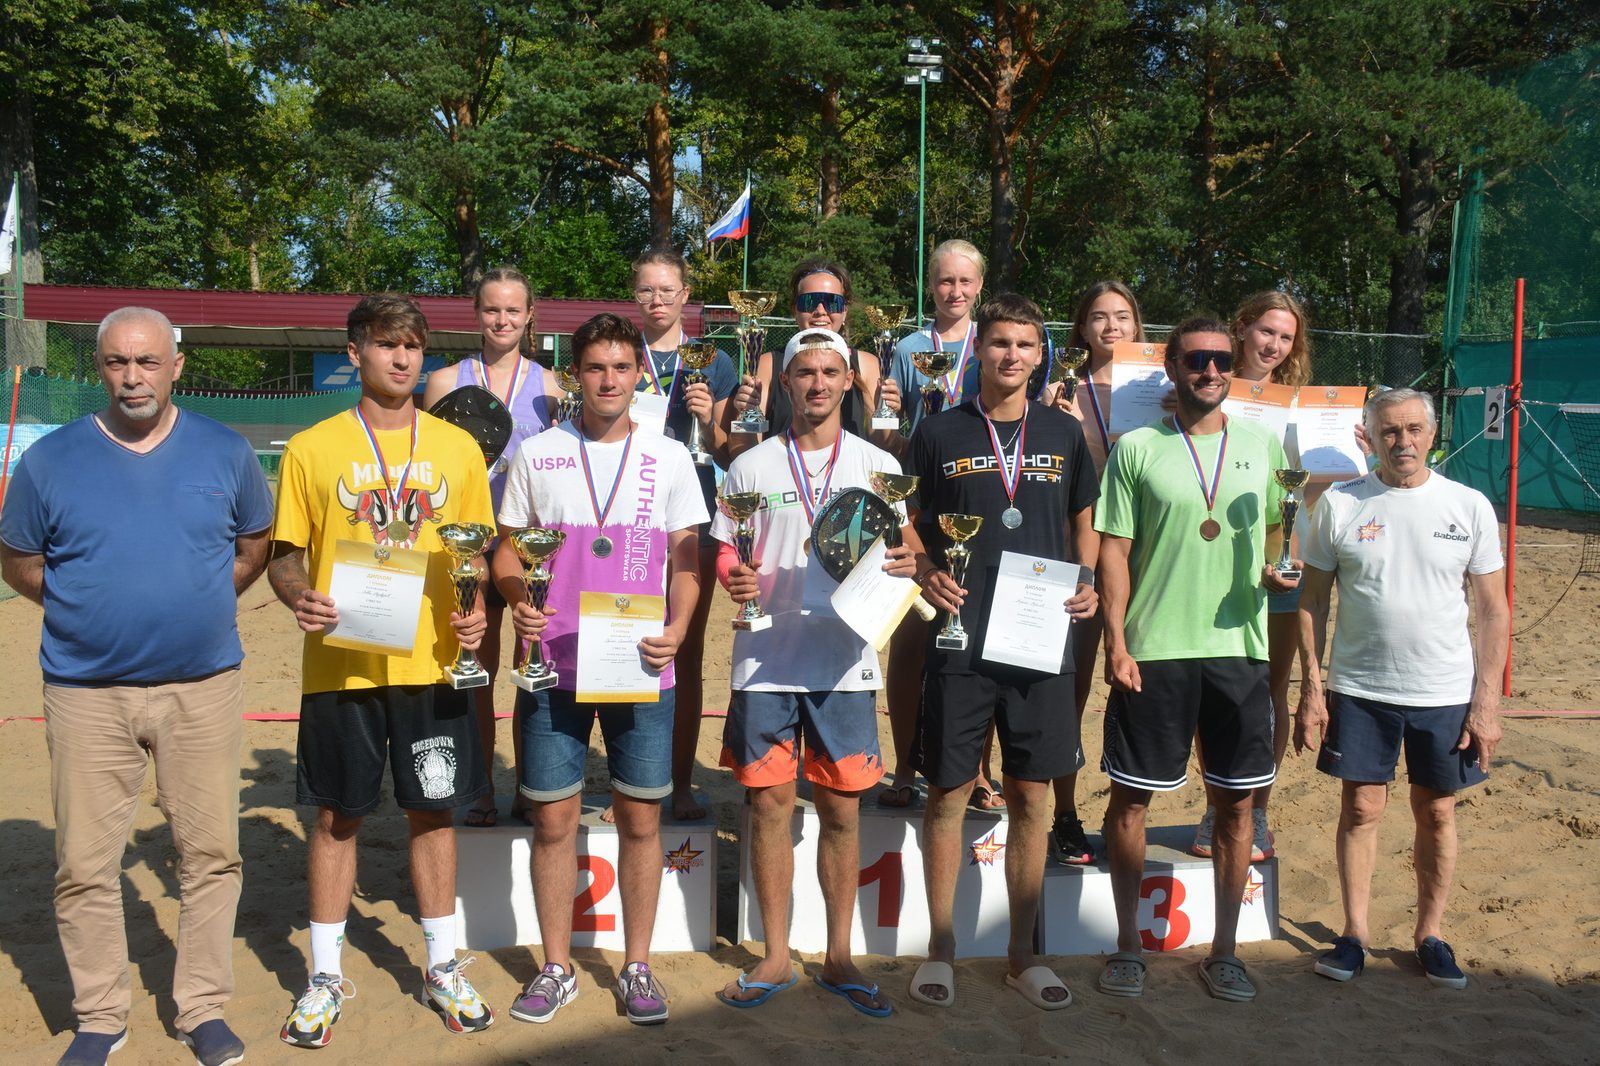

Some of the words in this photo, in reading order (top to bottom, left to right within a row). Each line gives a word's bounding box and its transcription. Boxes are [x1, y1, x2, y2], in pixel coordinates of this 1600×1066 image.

[1488, 401, 1500, 433] 2
[533, 456, 577, 471] USPA
[1023, 472, 1062, 484] TEAM
[630, 453, 657, 582] AUTHENTIC
[622, 528, 631, 582] SPORTSWEAR
[411, 736, 455, 755] FACEDOWN
[571, 855, 616, 932] 2
[858, 851, 903, 928] 1
[1139, 875, 1191, 951] 3
